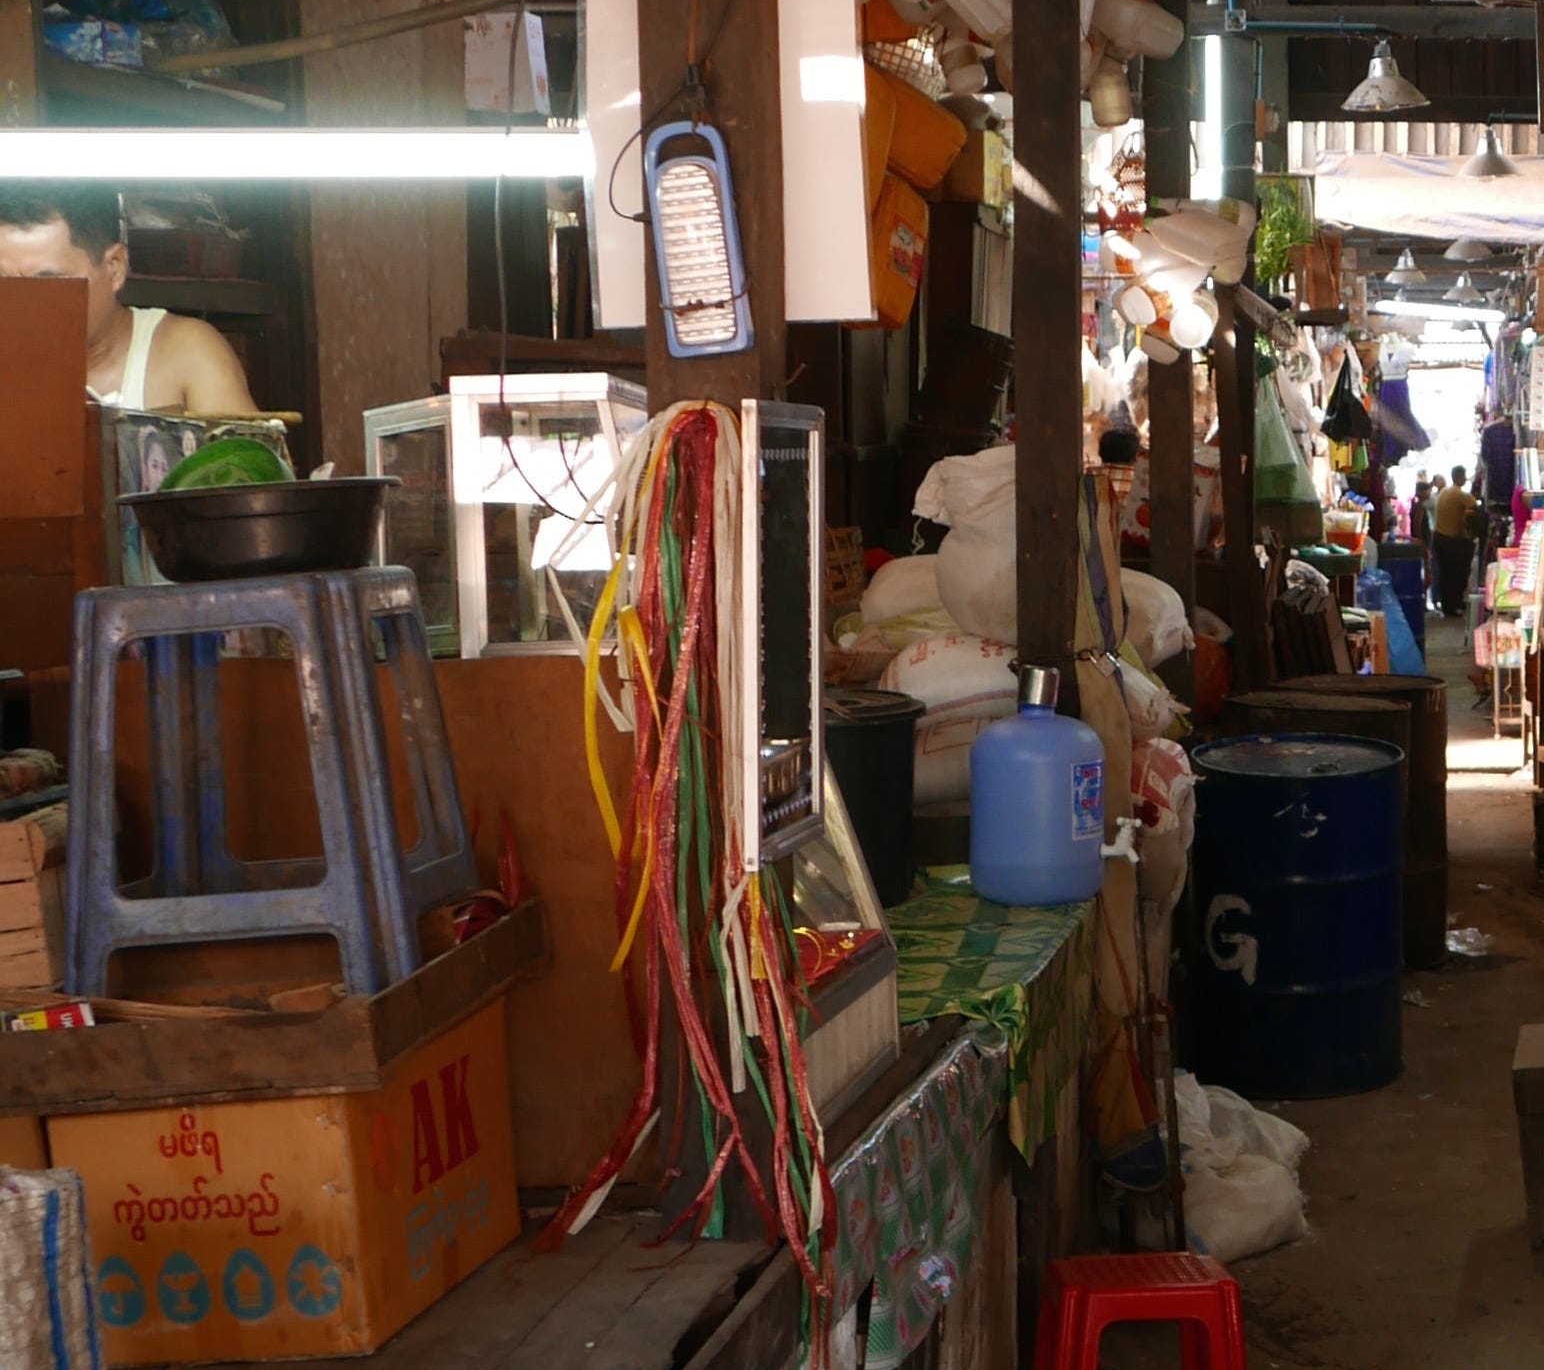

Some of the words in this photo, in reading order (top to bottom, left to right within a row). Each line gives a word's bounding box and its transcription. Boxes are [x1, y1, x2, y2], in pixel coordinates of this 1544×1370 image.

[409, 1053, 481, 1196] AK
[113, 1172, 281, 1242] ကွဲတတ်သည်
